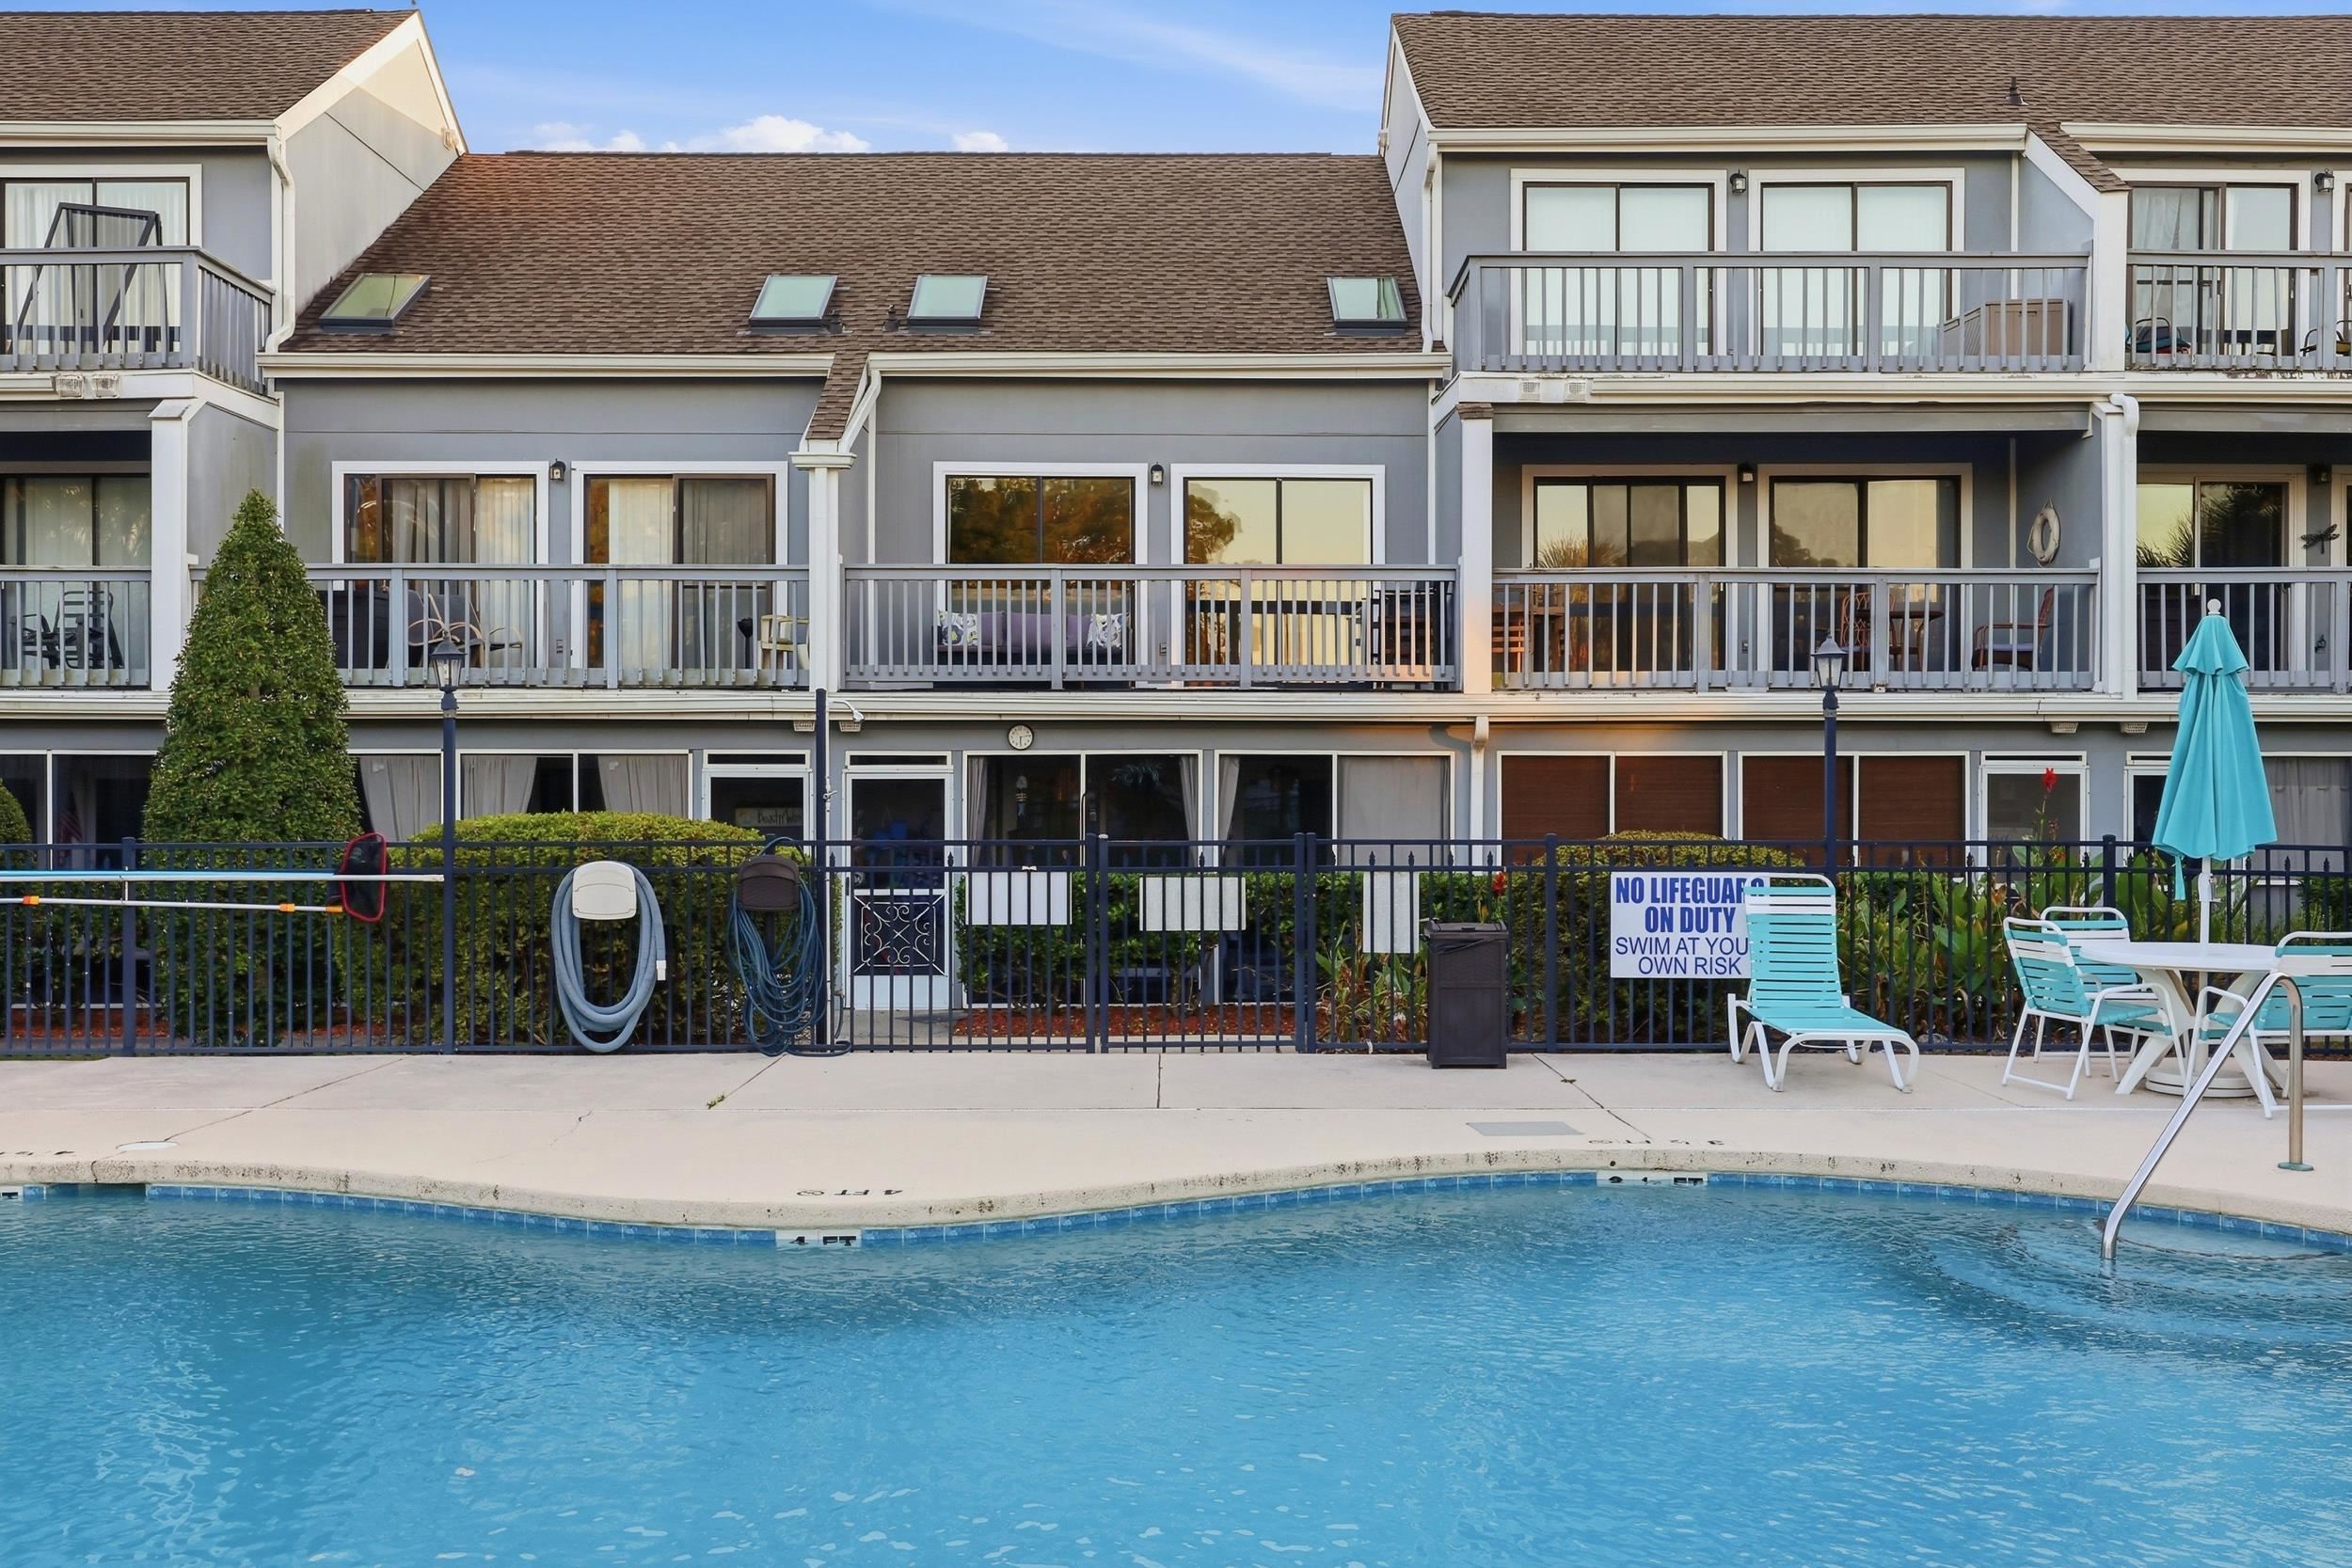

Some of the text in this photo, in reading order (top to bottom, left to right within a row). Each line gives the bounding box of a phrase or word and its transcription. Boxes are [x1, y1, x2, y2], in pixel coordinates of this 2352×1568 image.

[1615, 877, 1645, 904] NO
[1645, 906, 1737, 933] ON DUTY
[1615, 937, 1670, 955] SWIM
[1675, 937, 1700, 955] AT
[1638, 957, 1741, 975] OWN RISK
